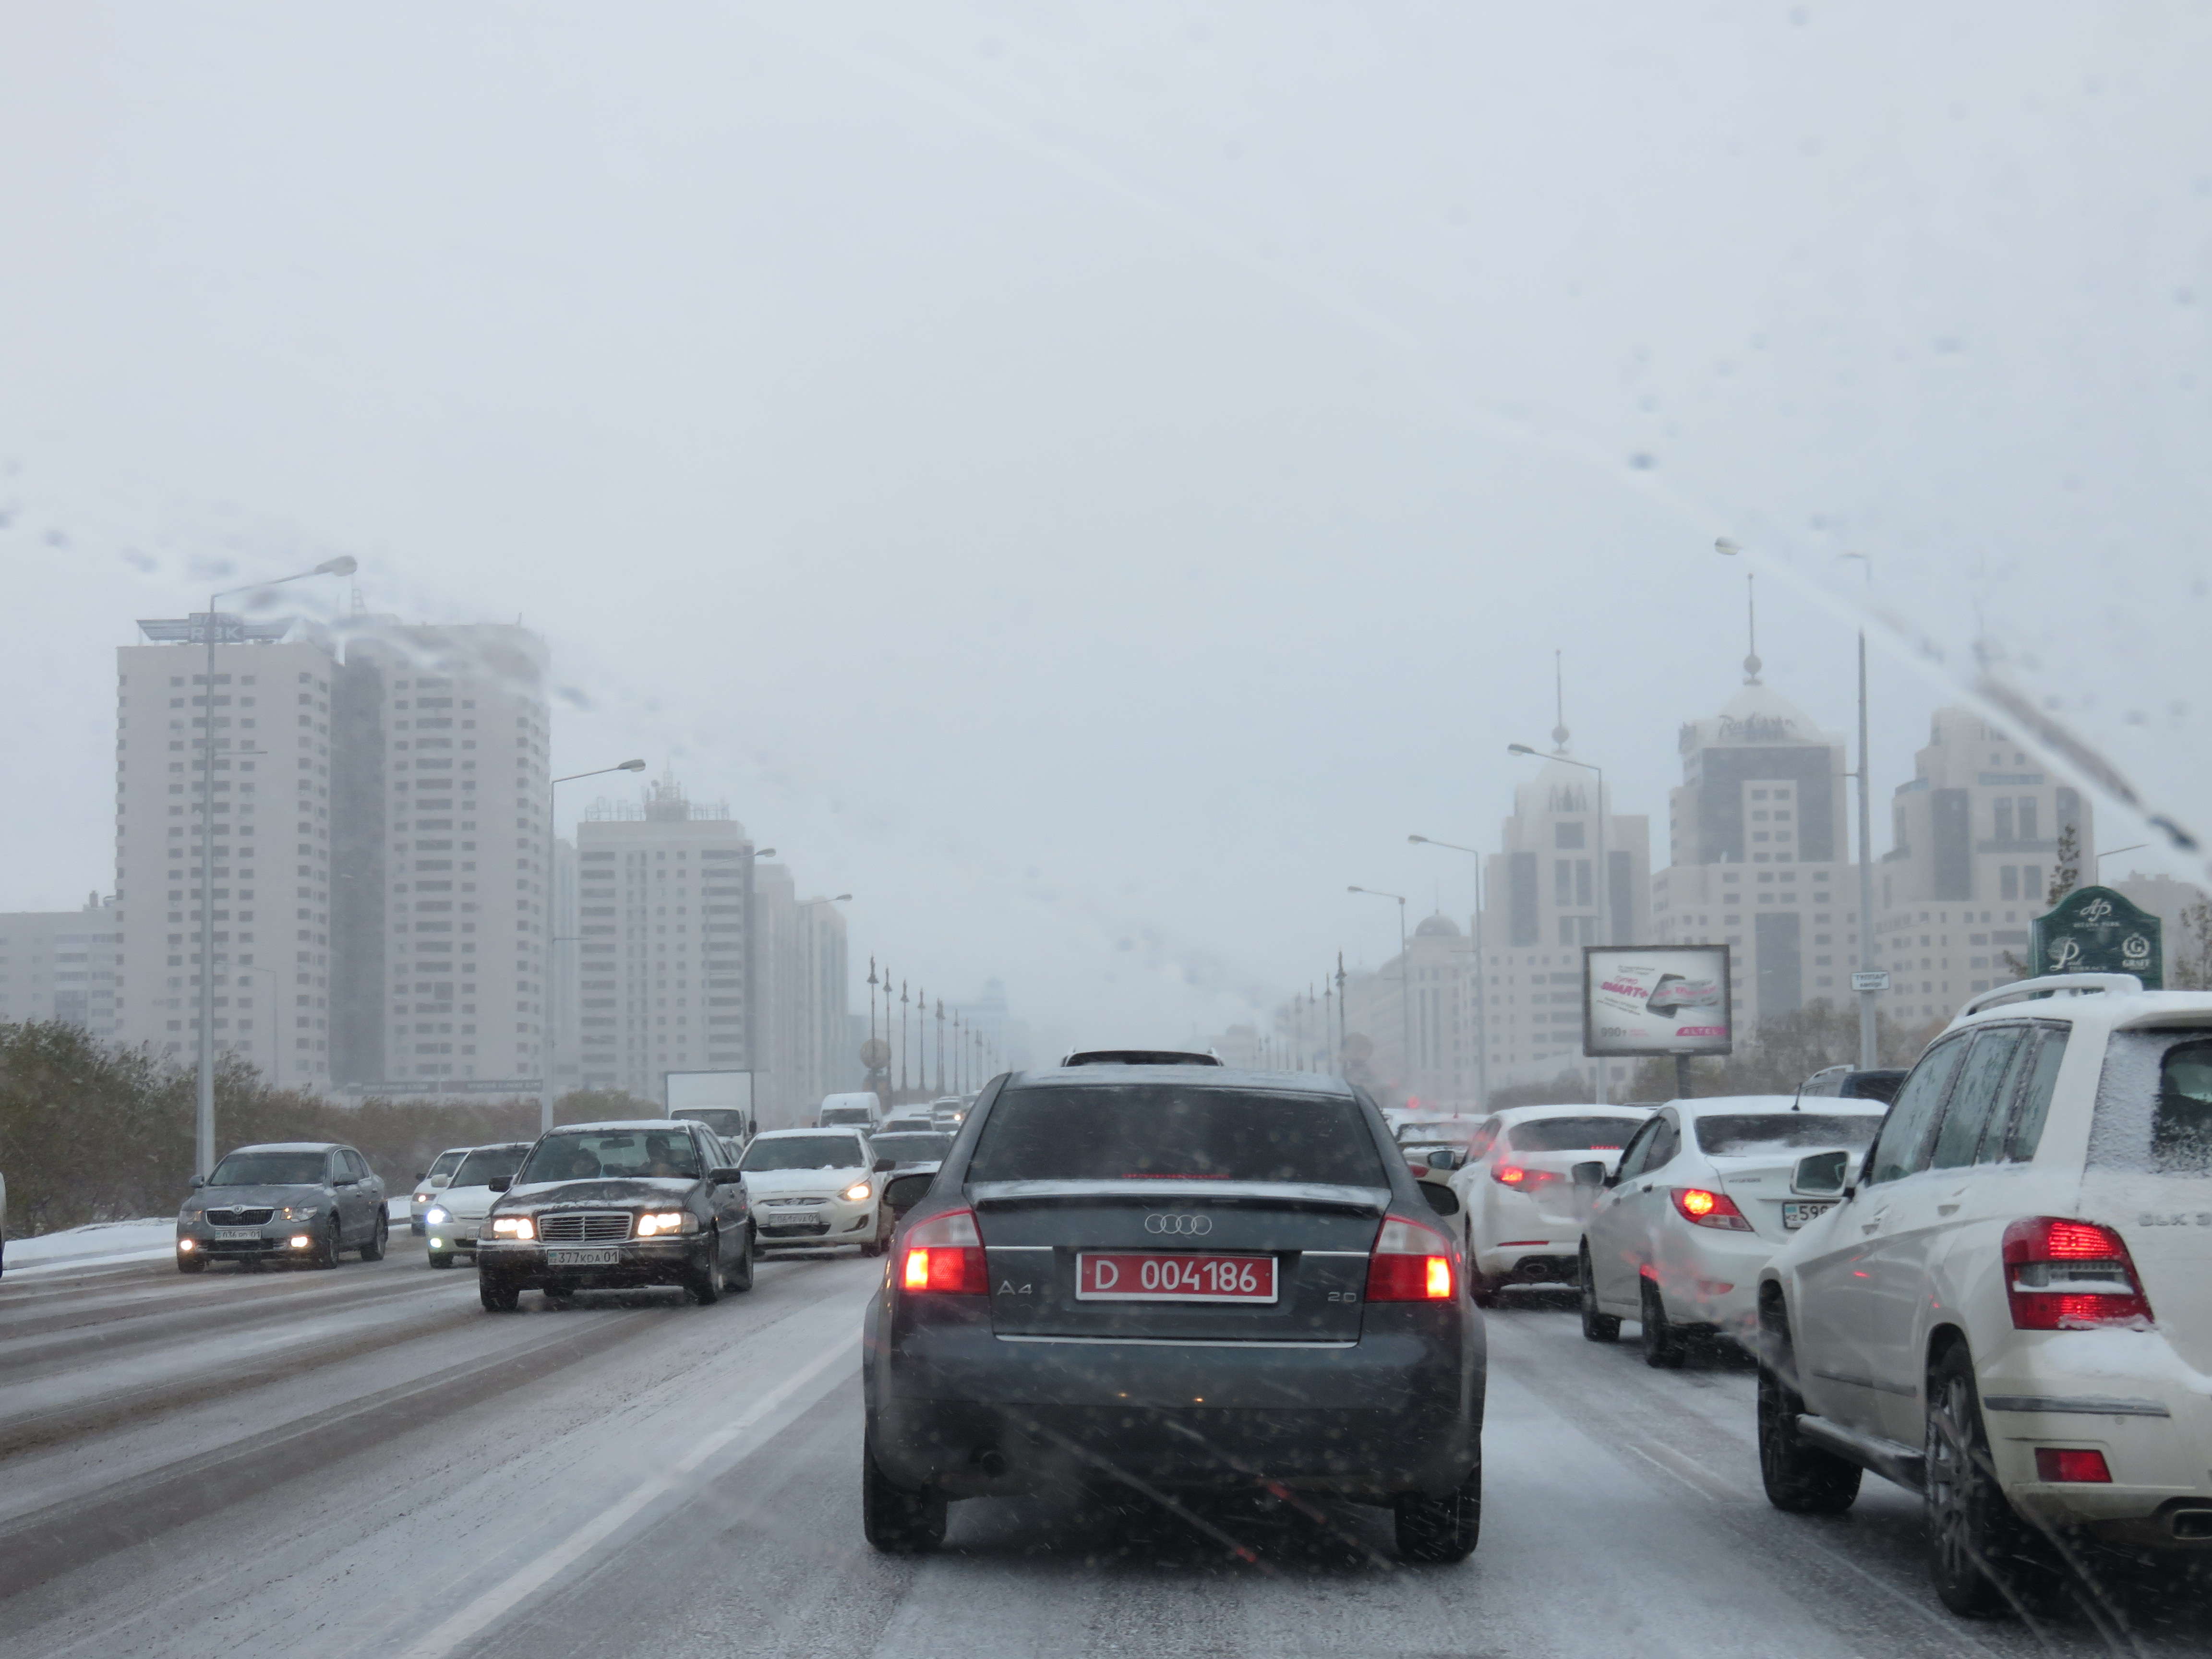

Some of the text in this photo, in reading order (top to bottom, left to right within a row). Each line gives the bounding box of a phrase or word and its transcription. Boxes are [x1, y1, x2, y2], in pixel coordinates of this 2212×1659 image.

[997, 1280, 1033, 1295] A4
[1095, 1260, 1257, 1292] D 004186
